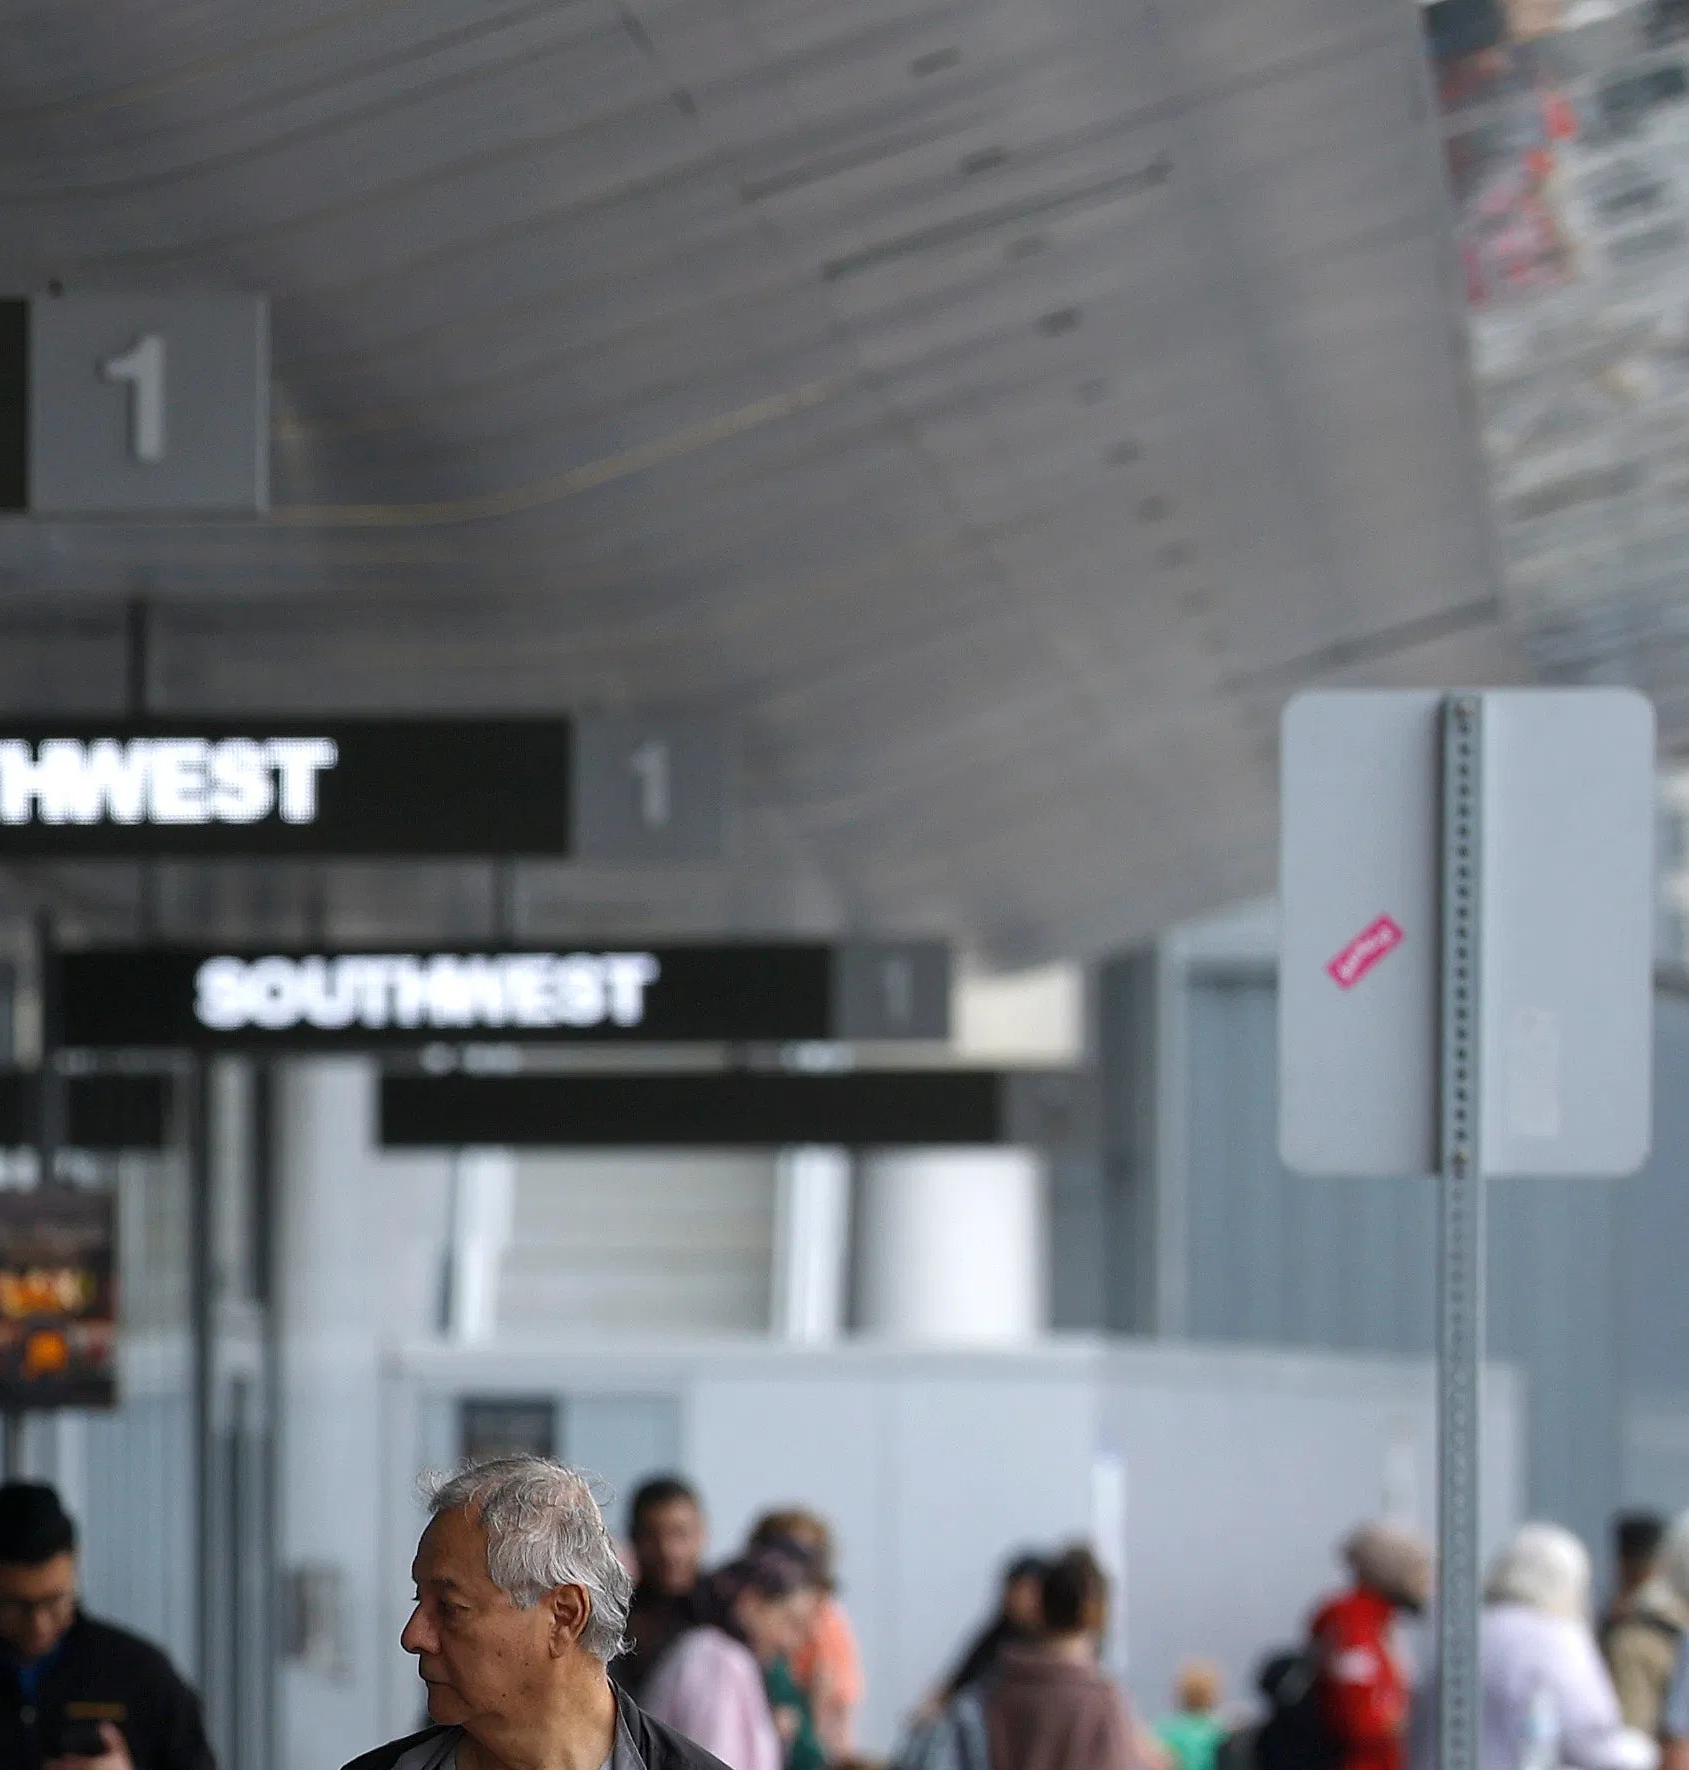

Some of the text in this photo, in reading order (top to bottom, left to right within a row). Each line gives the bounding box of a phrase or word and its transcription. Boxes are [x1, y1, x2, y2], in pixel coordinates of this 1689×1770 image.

[104, 333, 166, 462] 1
[627, 739, 671, 826] 1
[197, 953, 657, 1030] SOUTHWEST
